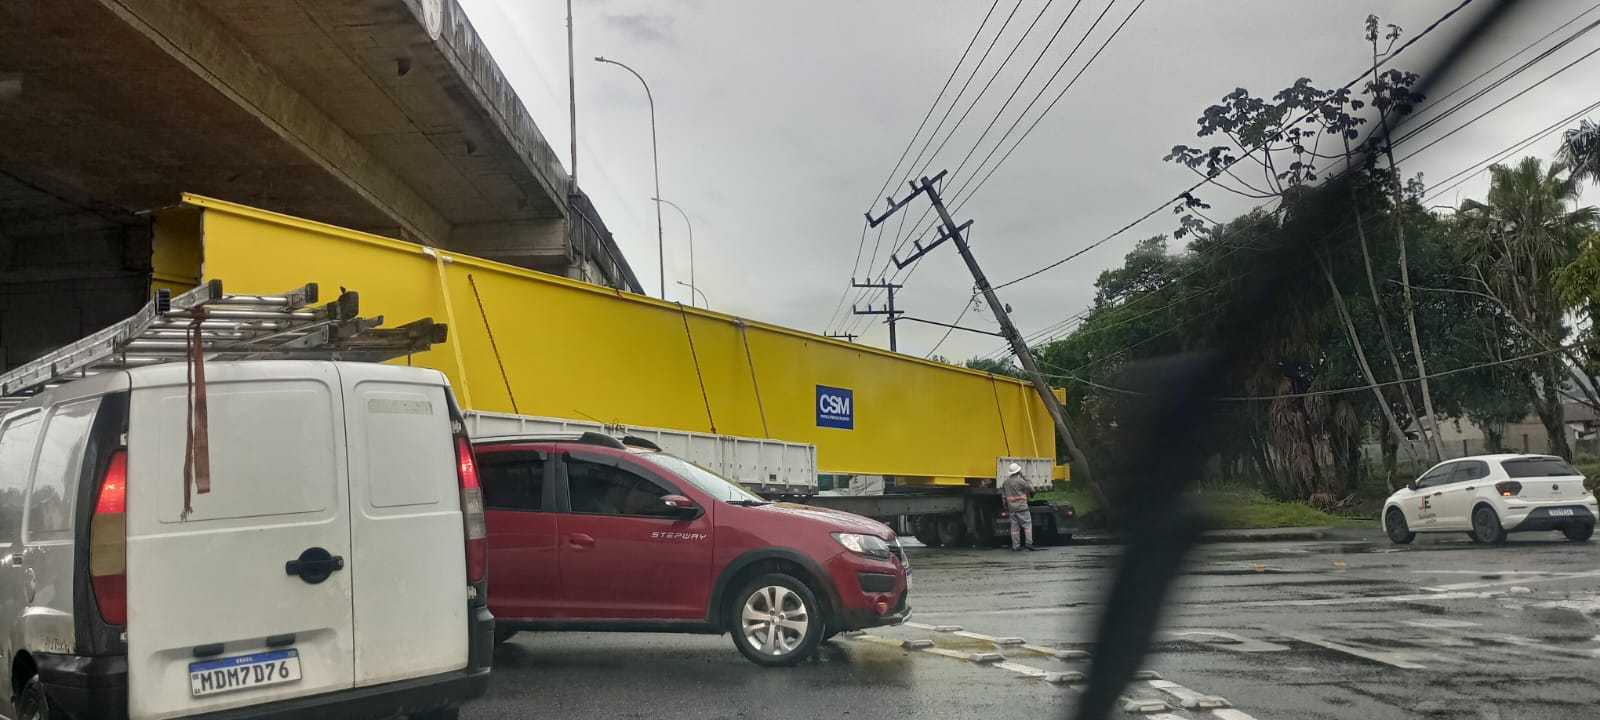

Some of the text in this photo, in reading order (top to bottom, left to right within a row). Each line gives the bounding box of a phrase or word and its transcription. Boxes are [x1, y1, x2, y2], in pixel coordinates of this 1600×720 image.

[820, 394, 850, 416] CSM
[651, 531, 707, 540] STEPWAY
[200, 661, 289, 692] MDM7D76
